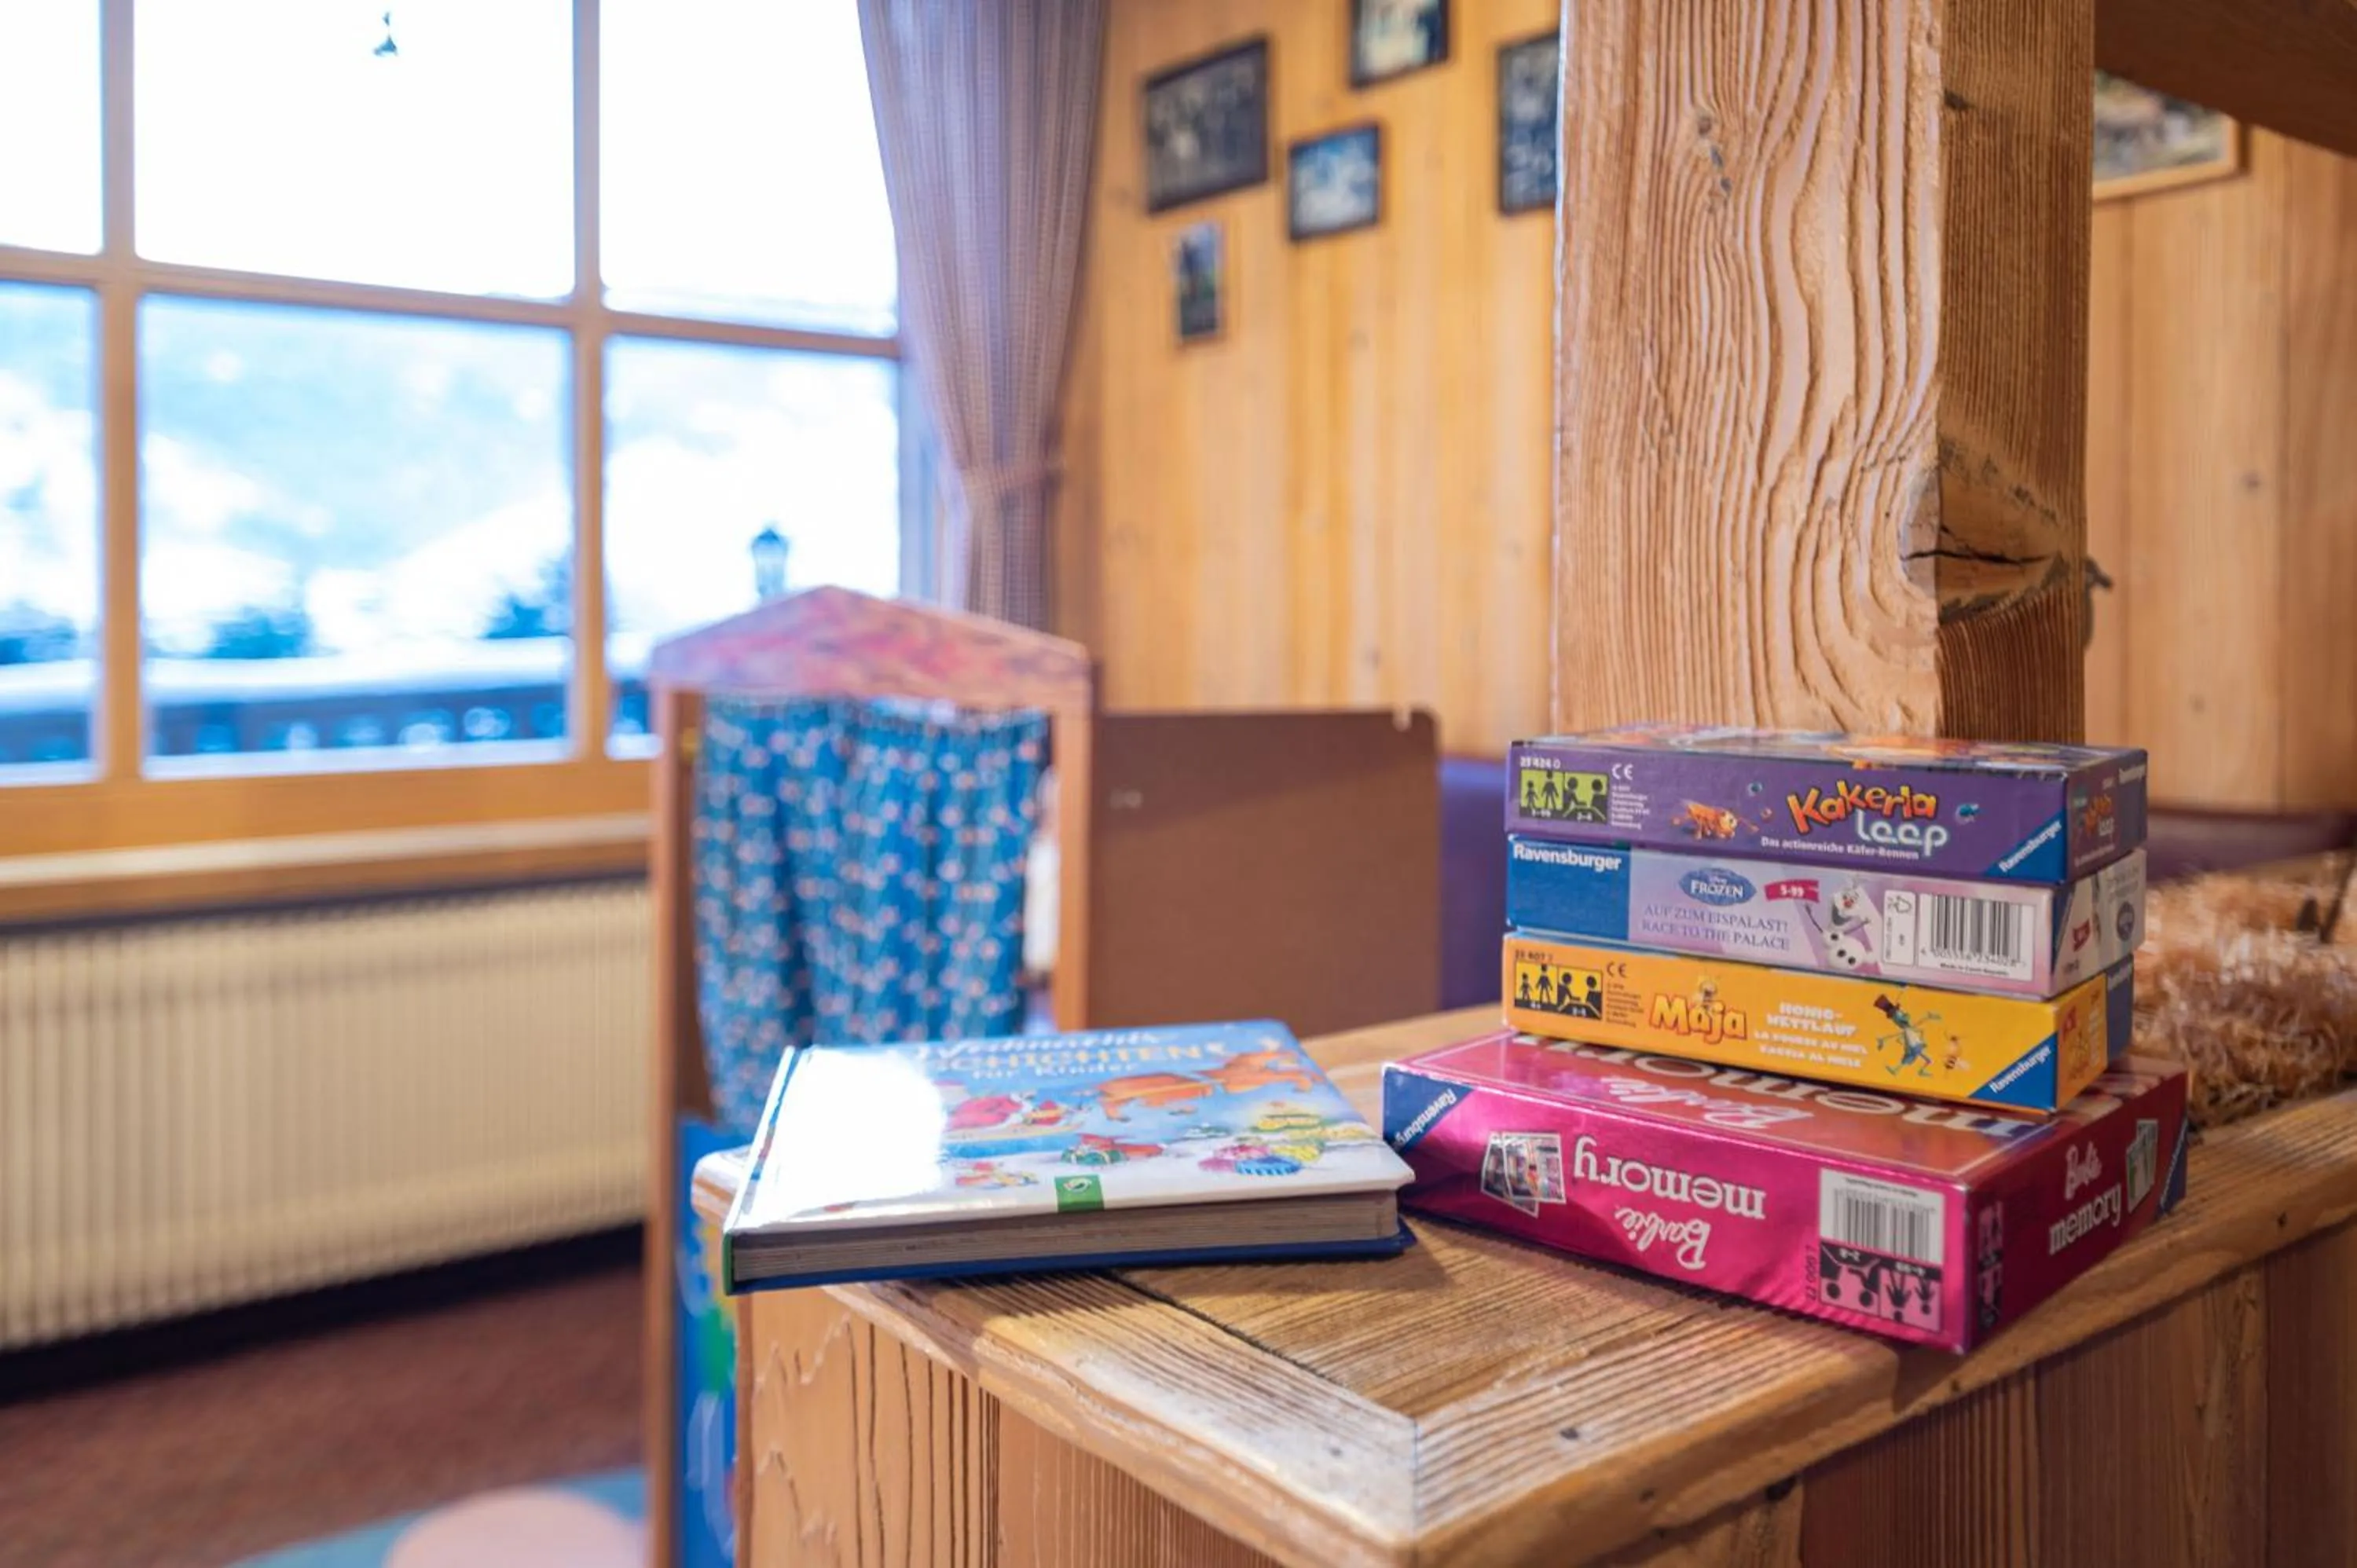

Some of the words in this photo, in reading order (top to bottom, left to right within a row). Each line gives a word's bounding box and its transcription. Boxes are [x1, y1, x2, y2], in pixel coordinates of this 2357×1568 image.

[1513, 843, 1622, 871] Ravensburger
[1761, 836, 1780, 848] Das
[1782, 838, 1845, 854] actionreiche
[1847, 843, 1919, 860] Käfer-Rennen
[1998, 820, 2062, 872] Ravensburger
[1644, 904, 1670, 918] AUF
[1674, 907, 1705, 922] ZUM
[1691, 879, 1744, 899] FROZEN
[1642, 919, 1676, 935] RACE
[1681, 924, 1700, 937] TO
[1703, 927, 1728, 942] THE
[1733, 932, 1791, 951] PALACE
[1649, 993, 1748, 1045] Maja
[1512, 1034, 2037, 1137] memor
[1989, 1045, 2052, 1094] Ravensburger
[1395, 1088, 1457, 1148] Ravensburg
[1573, 1136, 1766, 1219] memory
[1615, 1204, 1710, 1270] Barbie
[2049, 1181, 2121, 1255] memory
